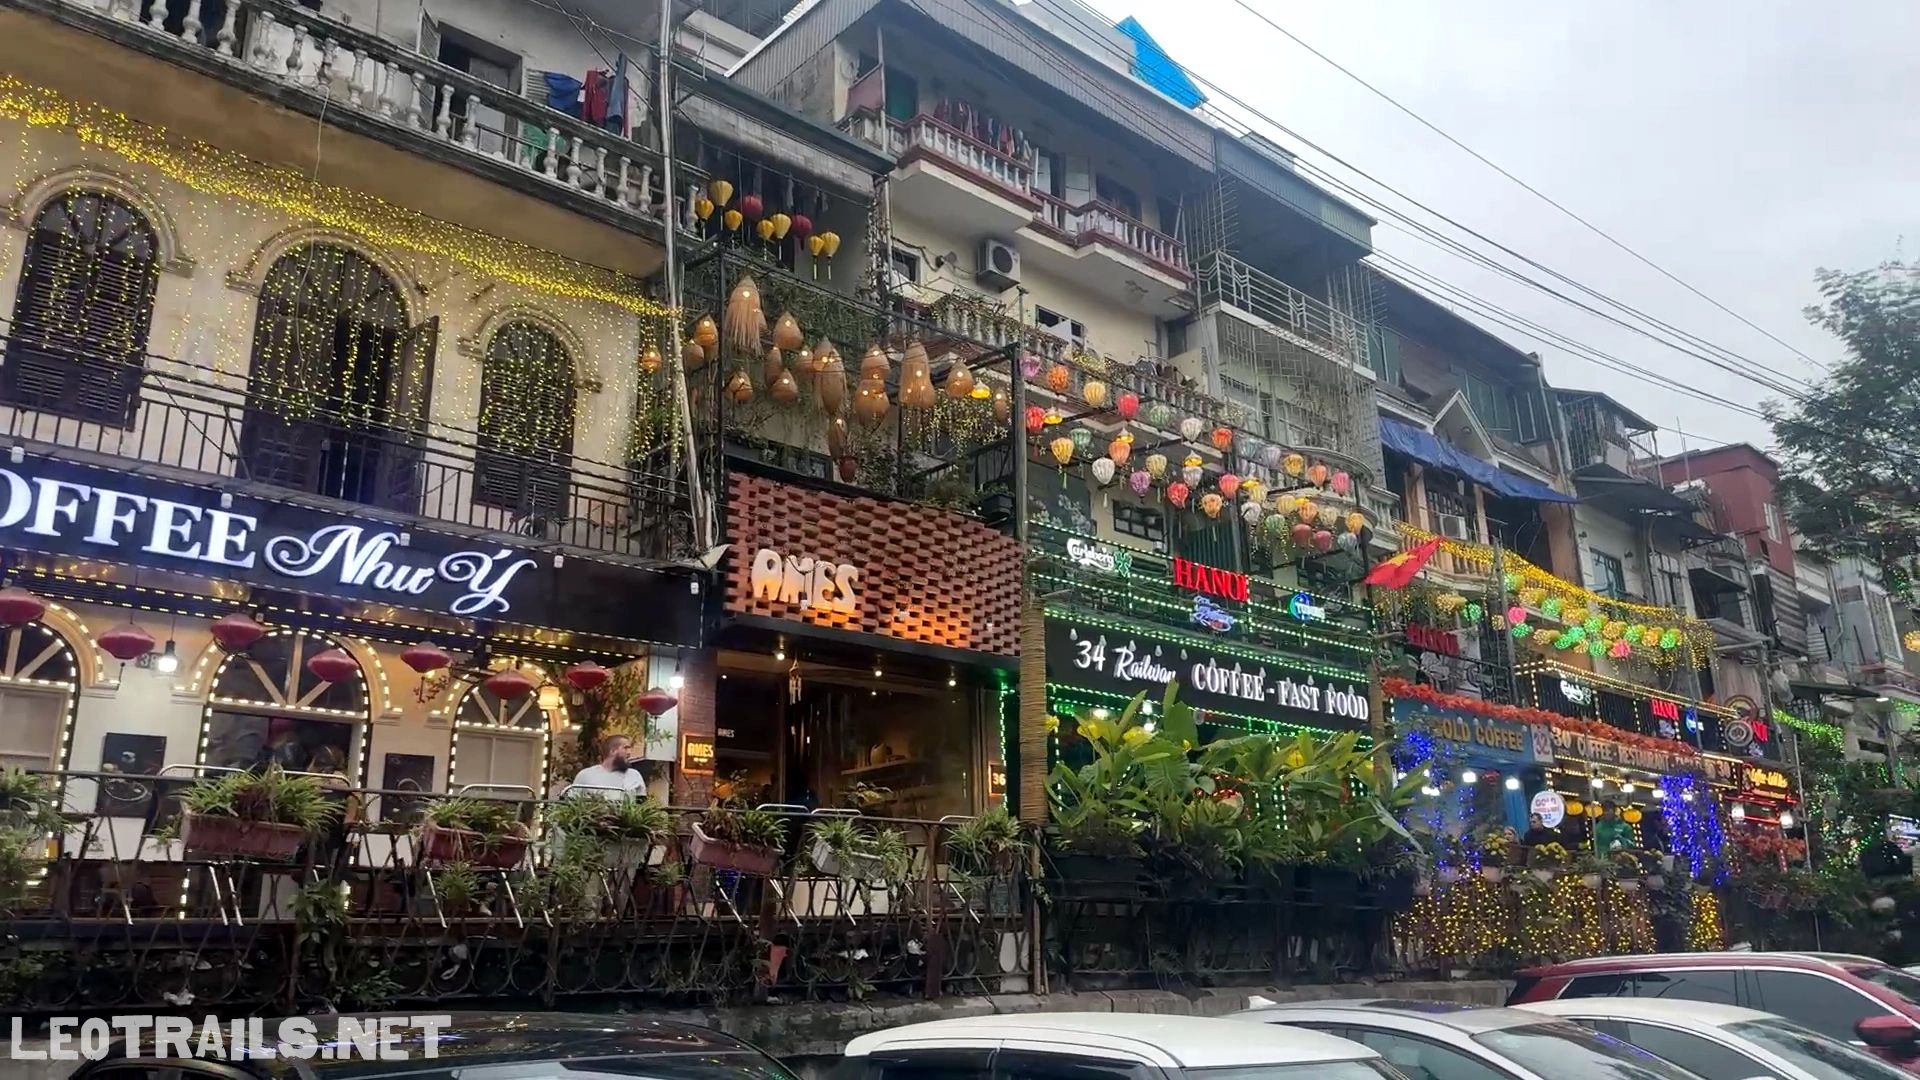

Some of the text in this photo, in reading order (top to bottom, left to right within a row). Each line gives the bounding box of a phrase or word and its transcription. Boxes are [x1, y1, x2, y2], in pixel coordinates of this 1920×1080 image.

[1066, 538, 1114, 570] Carlsberg
[751, 548, 859, 614] AMES
[1174, 556, 1248, 602] HANOI
[1073, 640, 1106, 672] 34
[1191, 662, 1266, 702] COFFEE
[1277, 680, 1320, 712] FAST
[1325, 689, 1369, 721] FOOD
[687, 742, 714, 758] AMES
[1476, 724, 1524, 753] COFFEE
[992, 772, 1006, 786] 36
